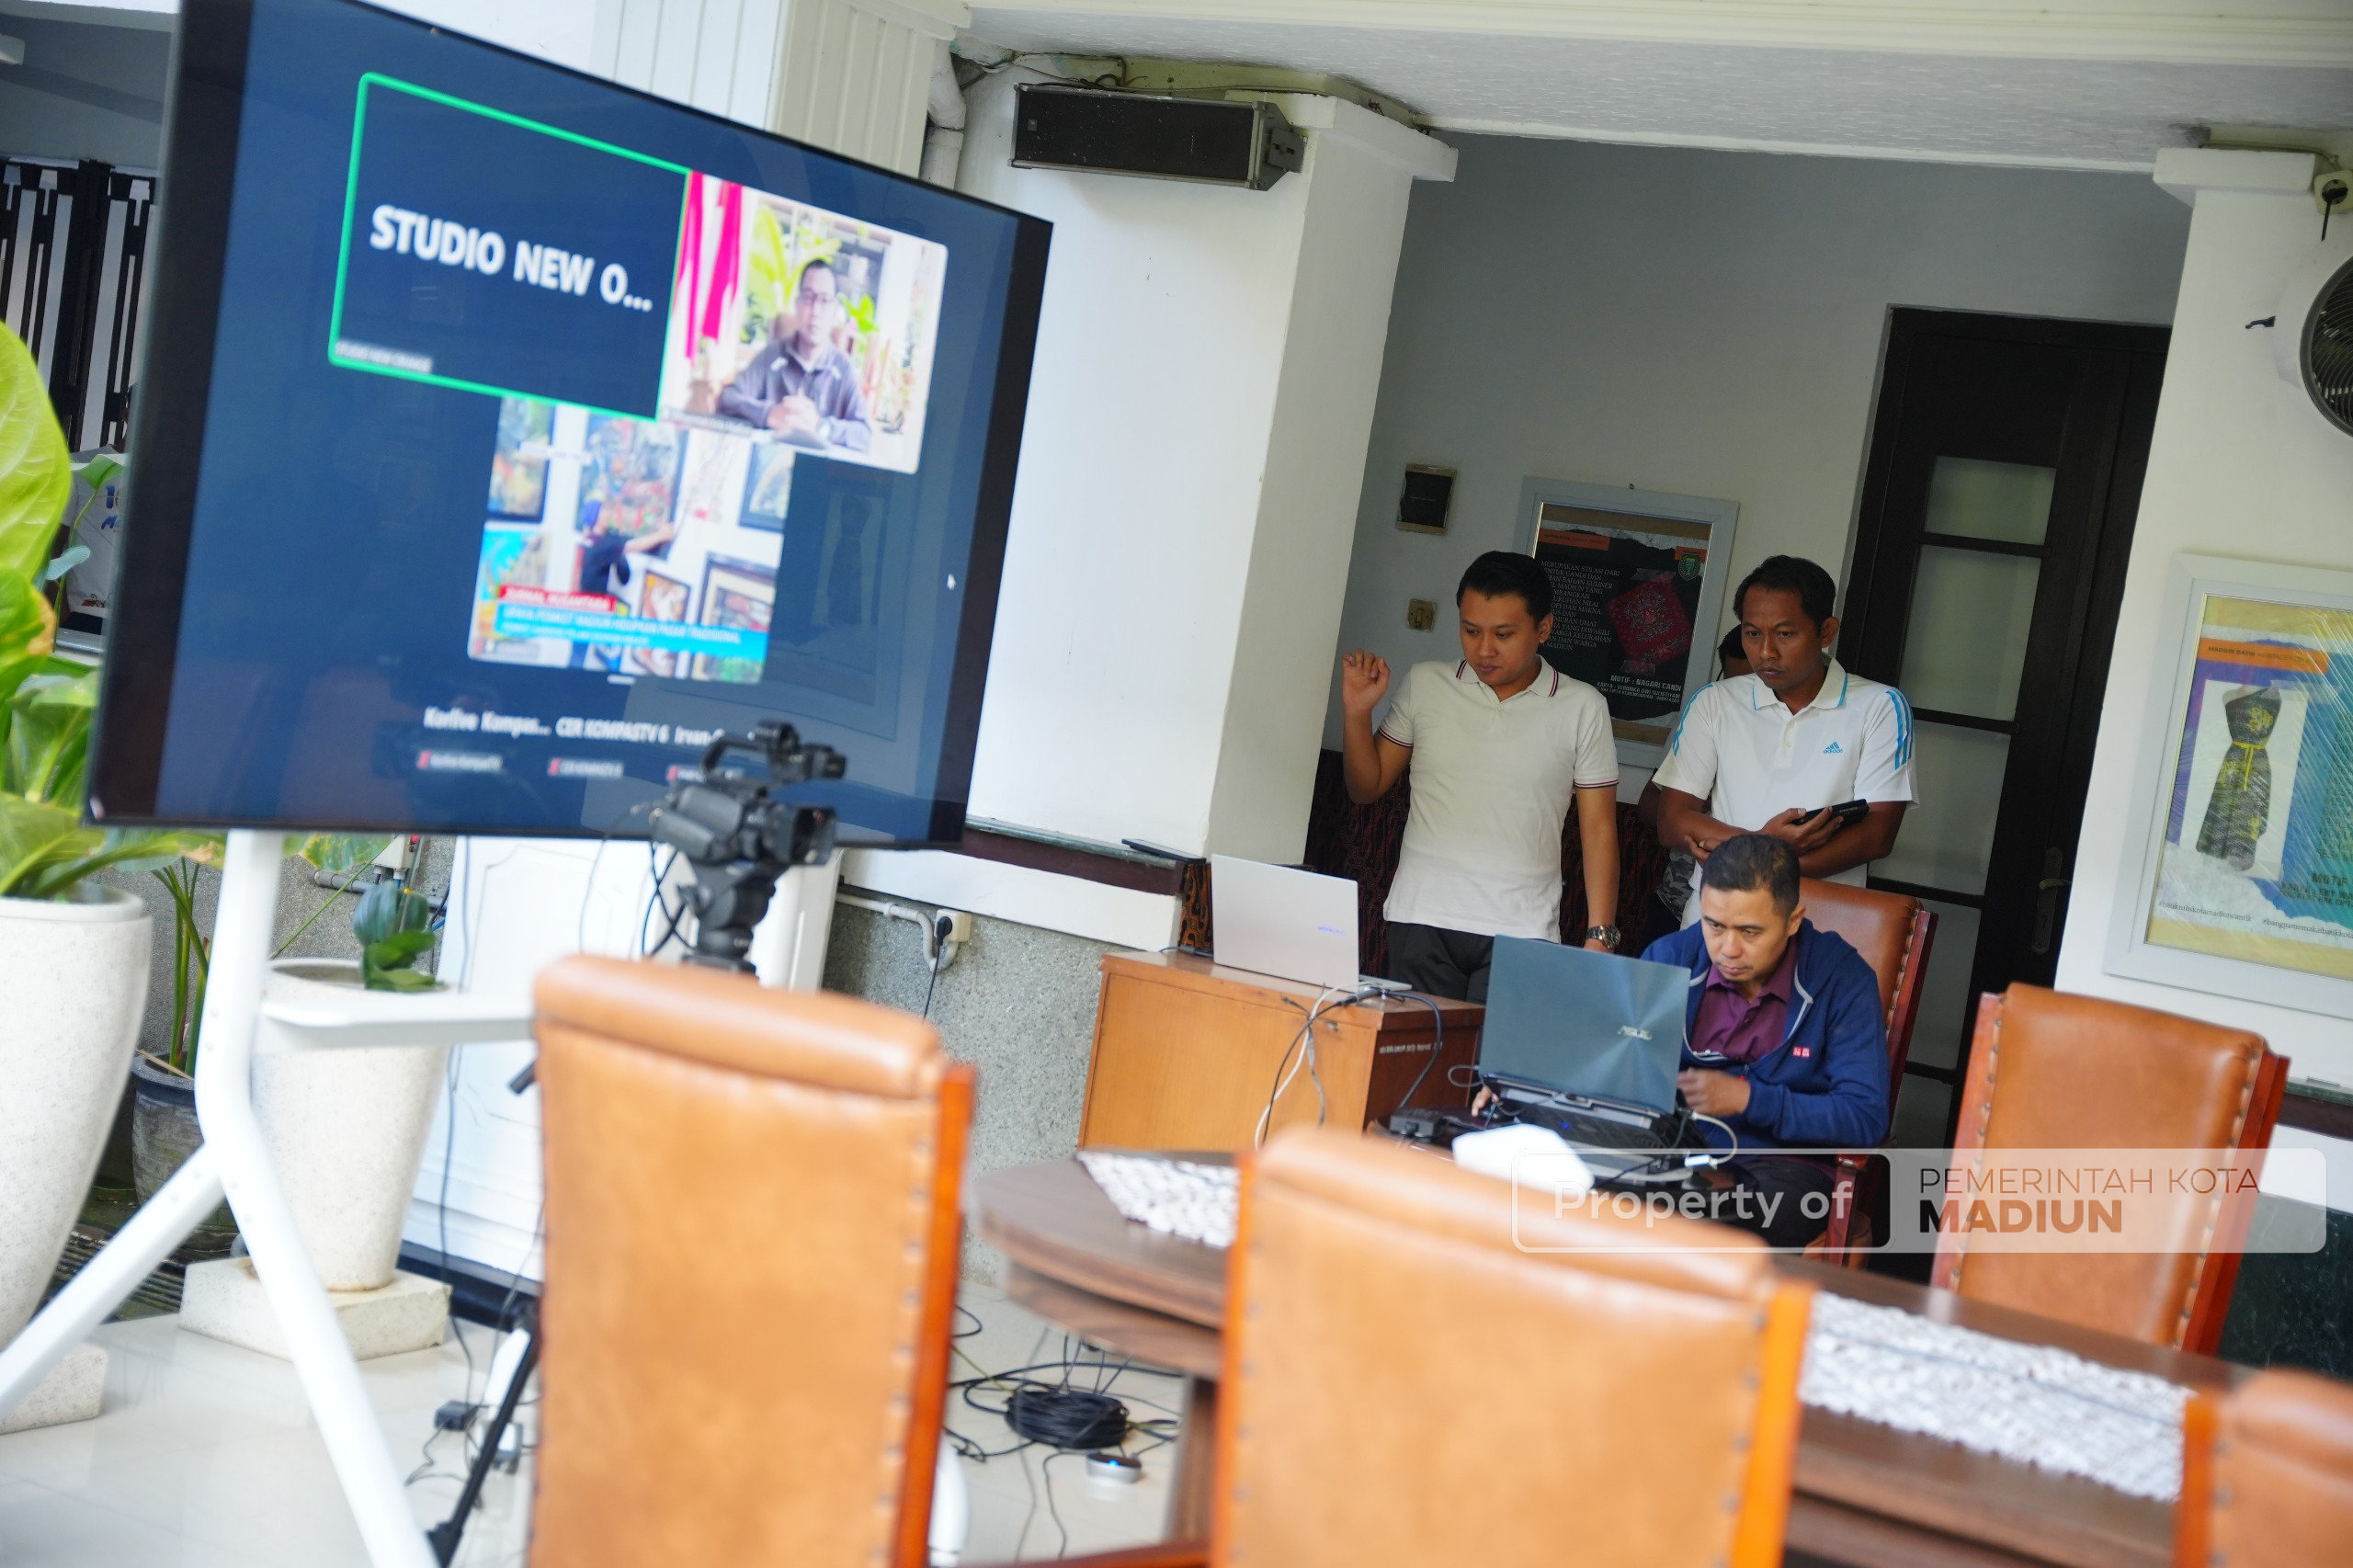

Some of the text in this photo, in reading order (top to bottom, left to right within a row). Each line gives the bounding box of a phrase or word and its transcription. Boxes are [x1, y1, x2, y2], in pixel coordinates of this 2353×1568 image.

[369, 204, 506, 275] STUDIO
[513, 240, 596, 296] NEW
[1540, 561, 1580, 571] MERUPAKAN
[1544, 567, 1564, 576] ENTUK
[1610, 675, 1631, 683] MOTIF
[1635, 678, 1661, 688] NAGARI
[1662, 682, 1682, 691] CANDI
